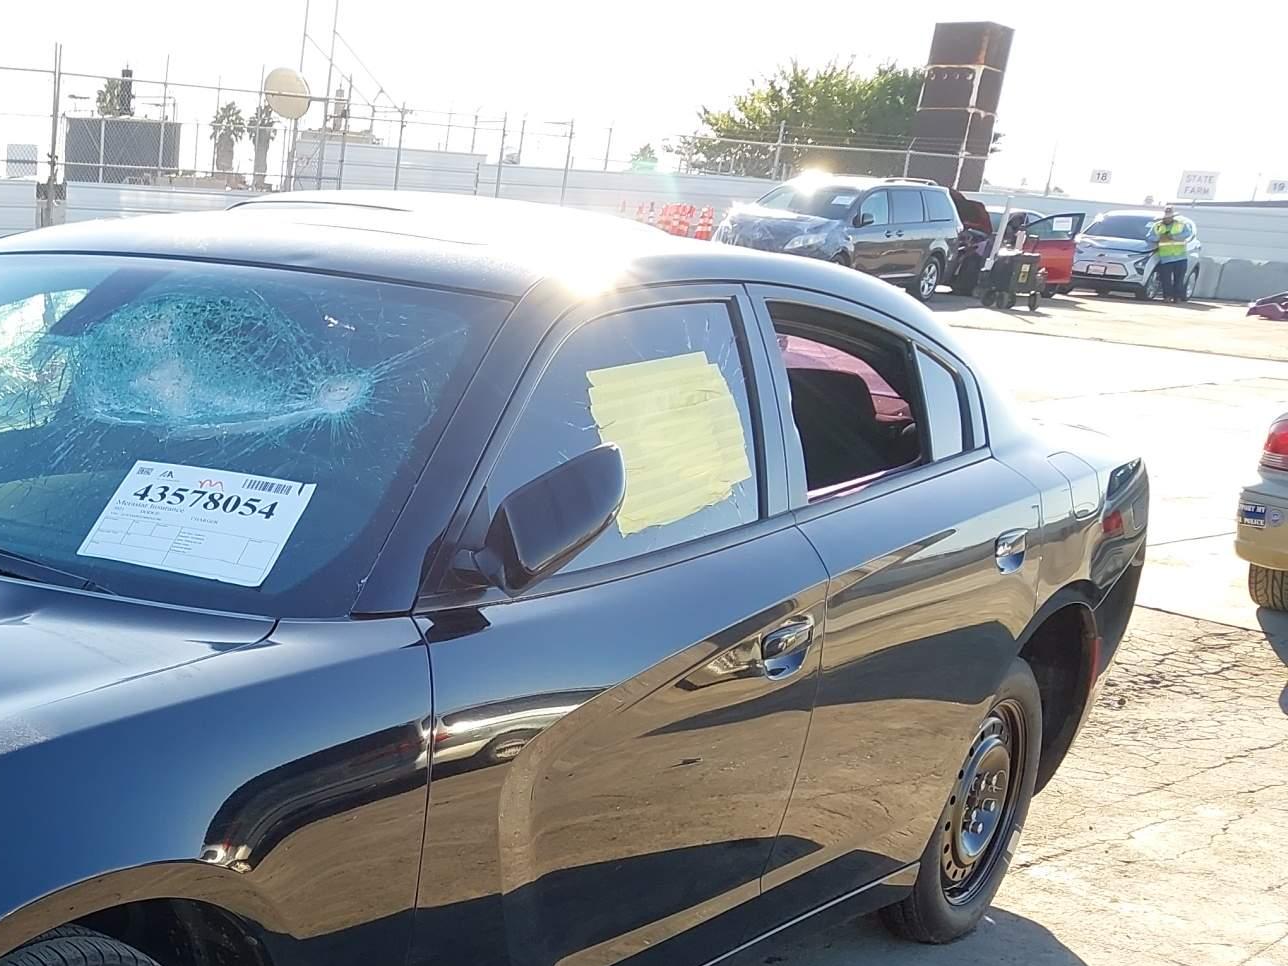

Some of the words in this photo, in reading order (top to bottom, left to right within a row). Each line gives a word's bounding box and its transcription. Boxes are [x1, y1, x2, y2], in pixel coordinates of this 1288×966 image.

[1096, 172, 1108, 182] 18
[1185, 174, 1214, 184] STATE
[1183, 185, 1209, 195] FARM
[1272, 182, 1285, 192] 19
[133, 484, 279, 519] 43578054
